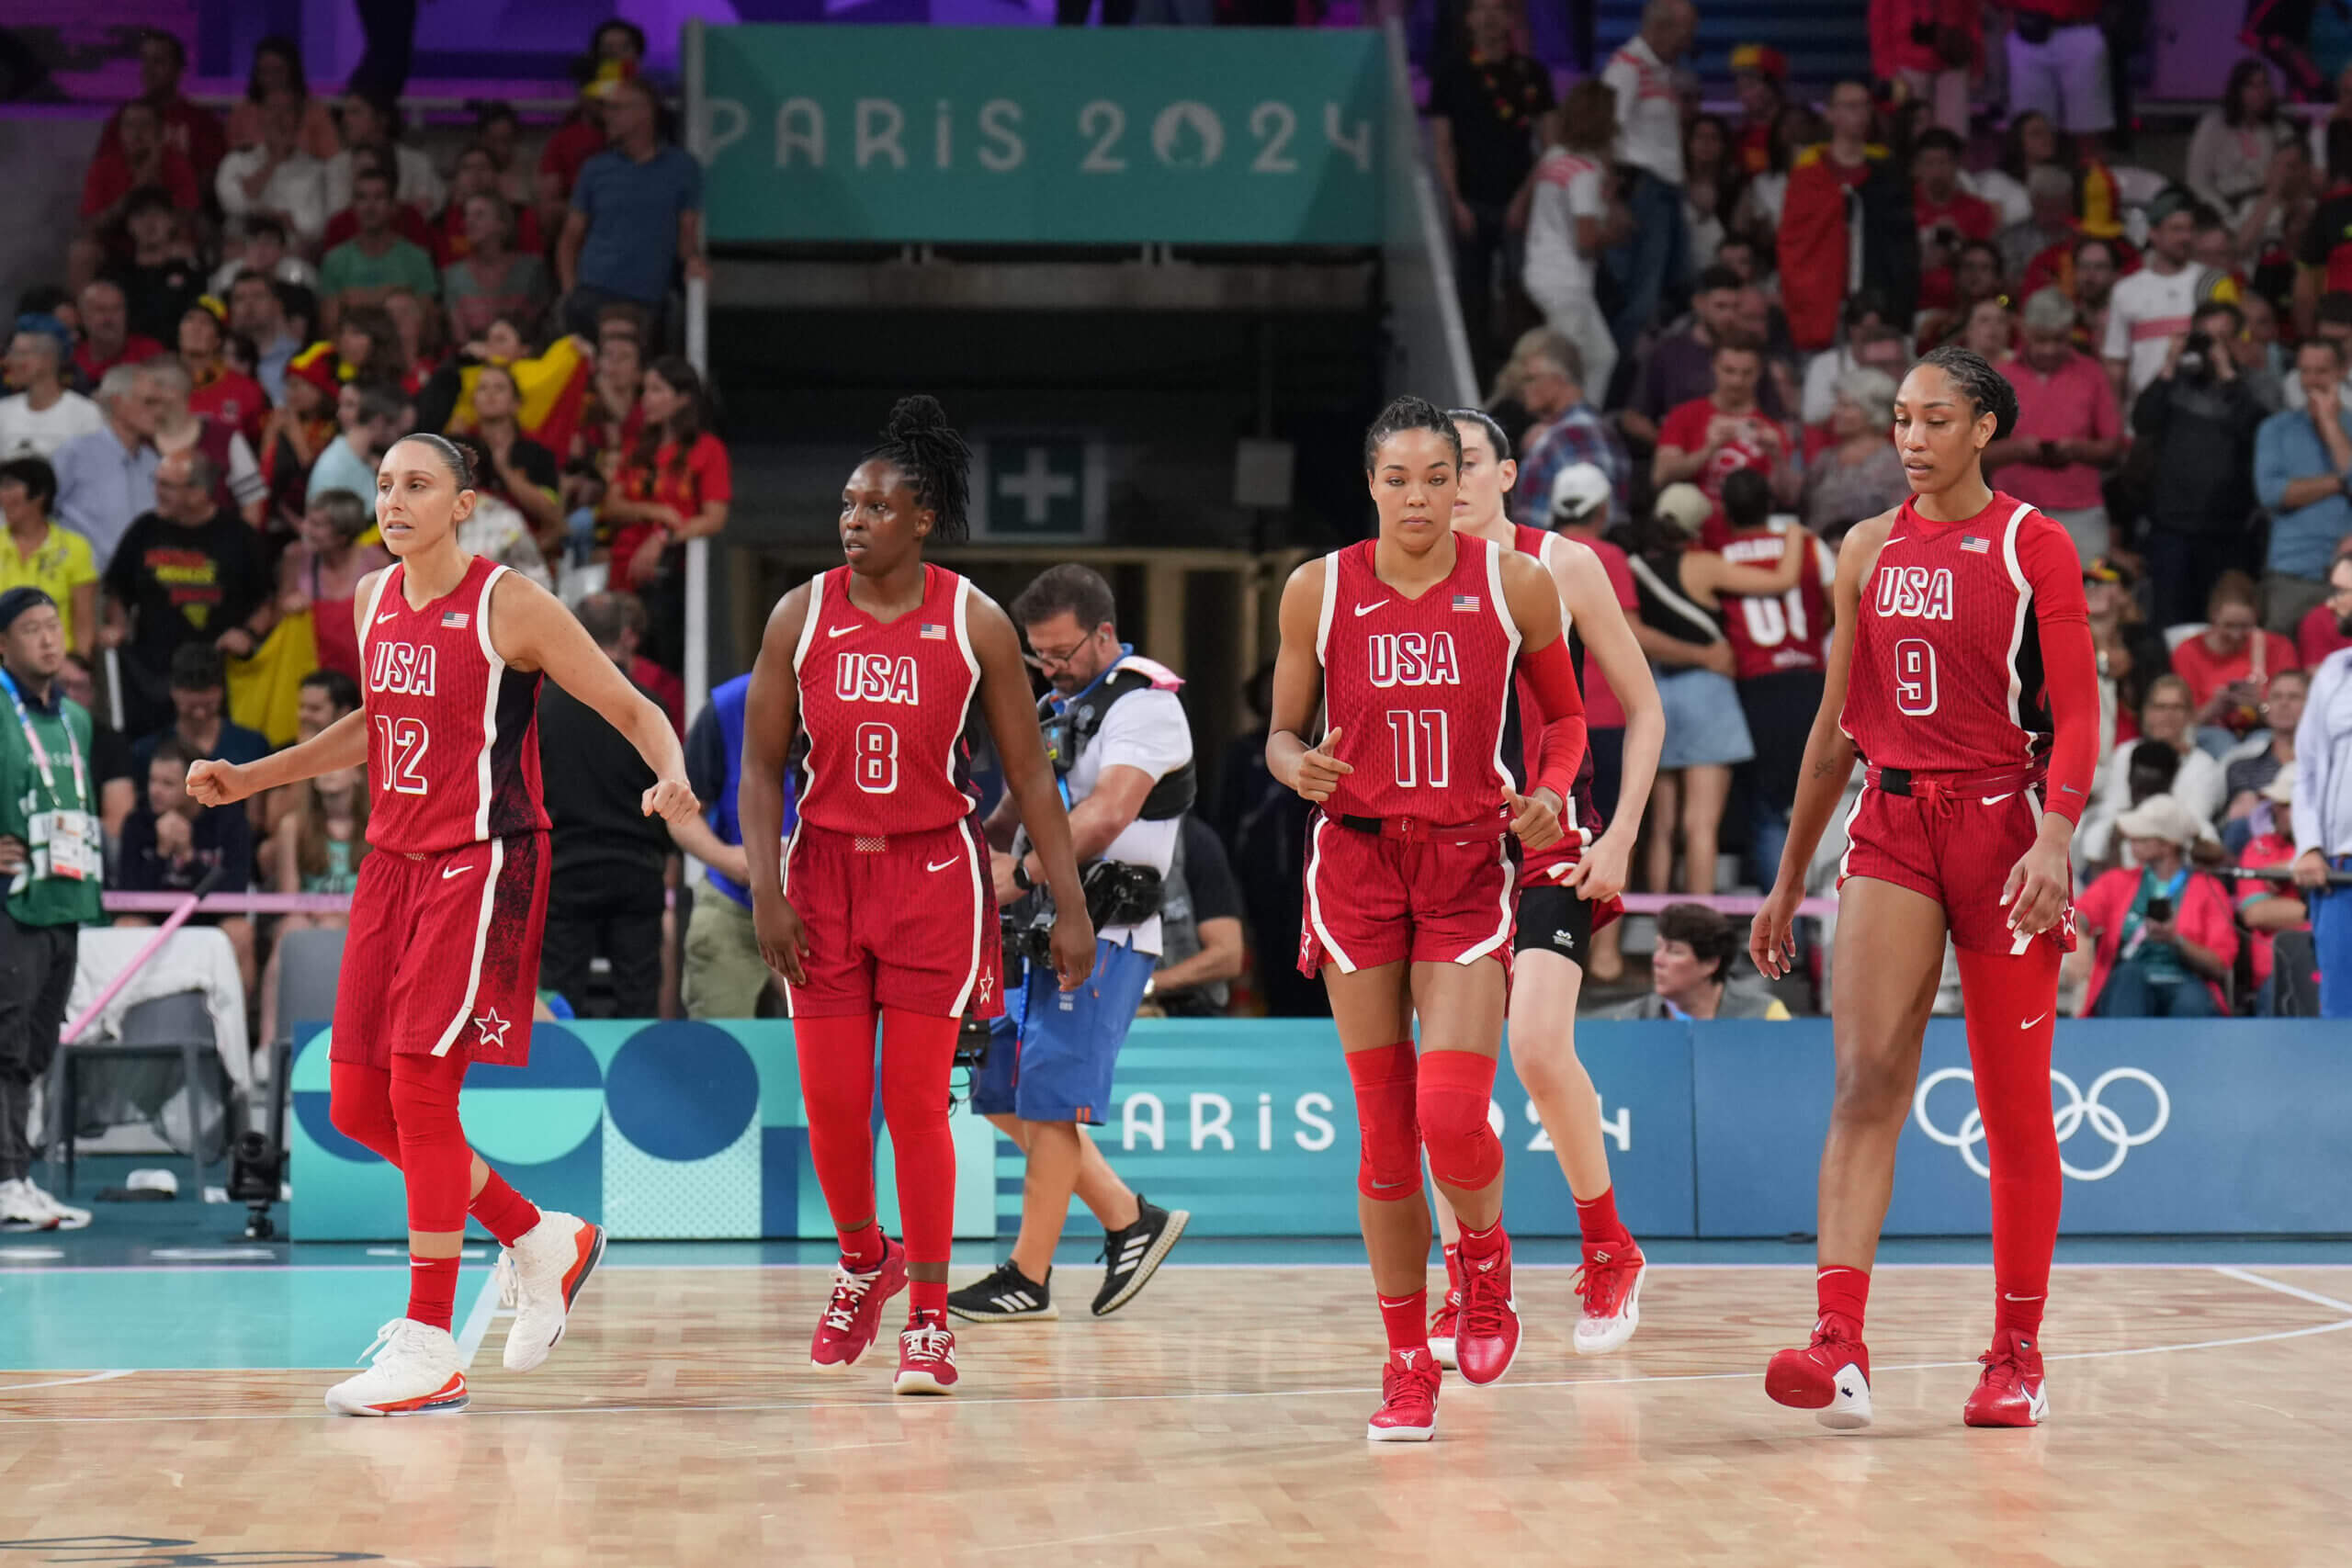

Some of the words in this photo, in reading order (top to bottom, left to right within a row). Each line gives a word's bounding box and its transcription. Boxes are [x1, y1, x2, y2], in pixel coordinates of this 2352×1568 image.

[1078, 98, 1373, 174] 2024
[1875, 567, 1953, 621] USA
[369, 641, 436, 697] USA
[836, 652, 920, 705] USA
[1368, 631, 1461, 688] USA
[1895, 638, 1939, 716] 9
[374, 715, 429, 795] 12
[855, 721, 899, 795] 8
[1386, 709, 1449, 788] 11
[1122, 1091, 1336, 1152] ARiS
